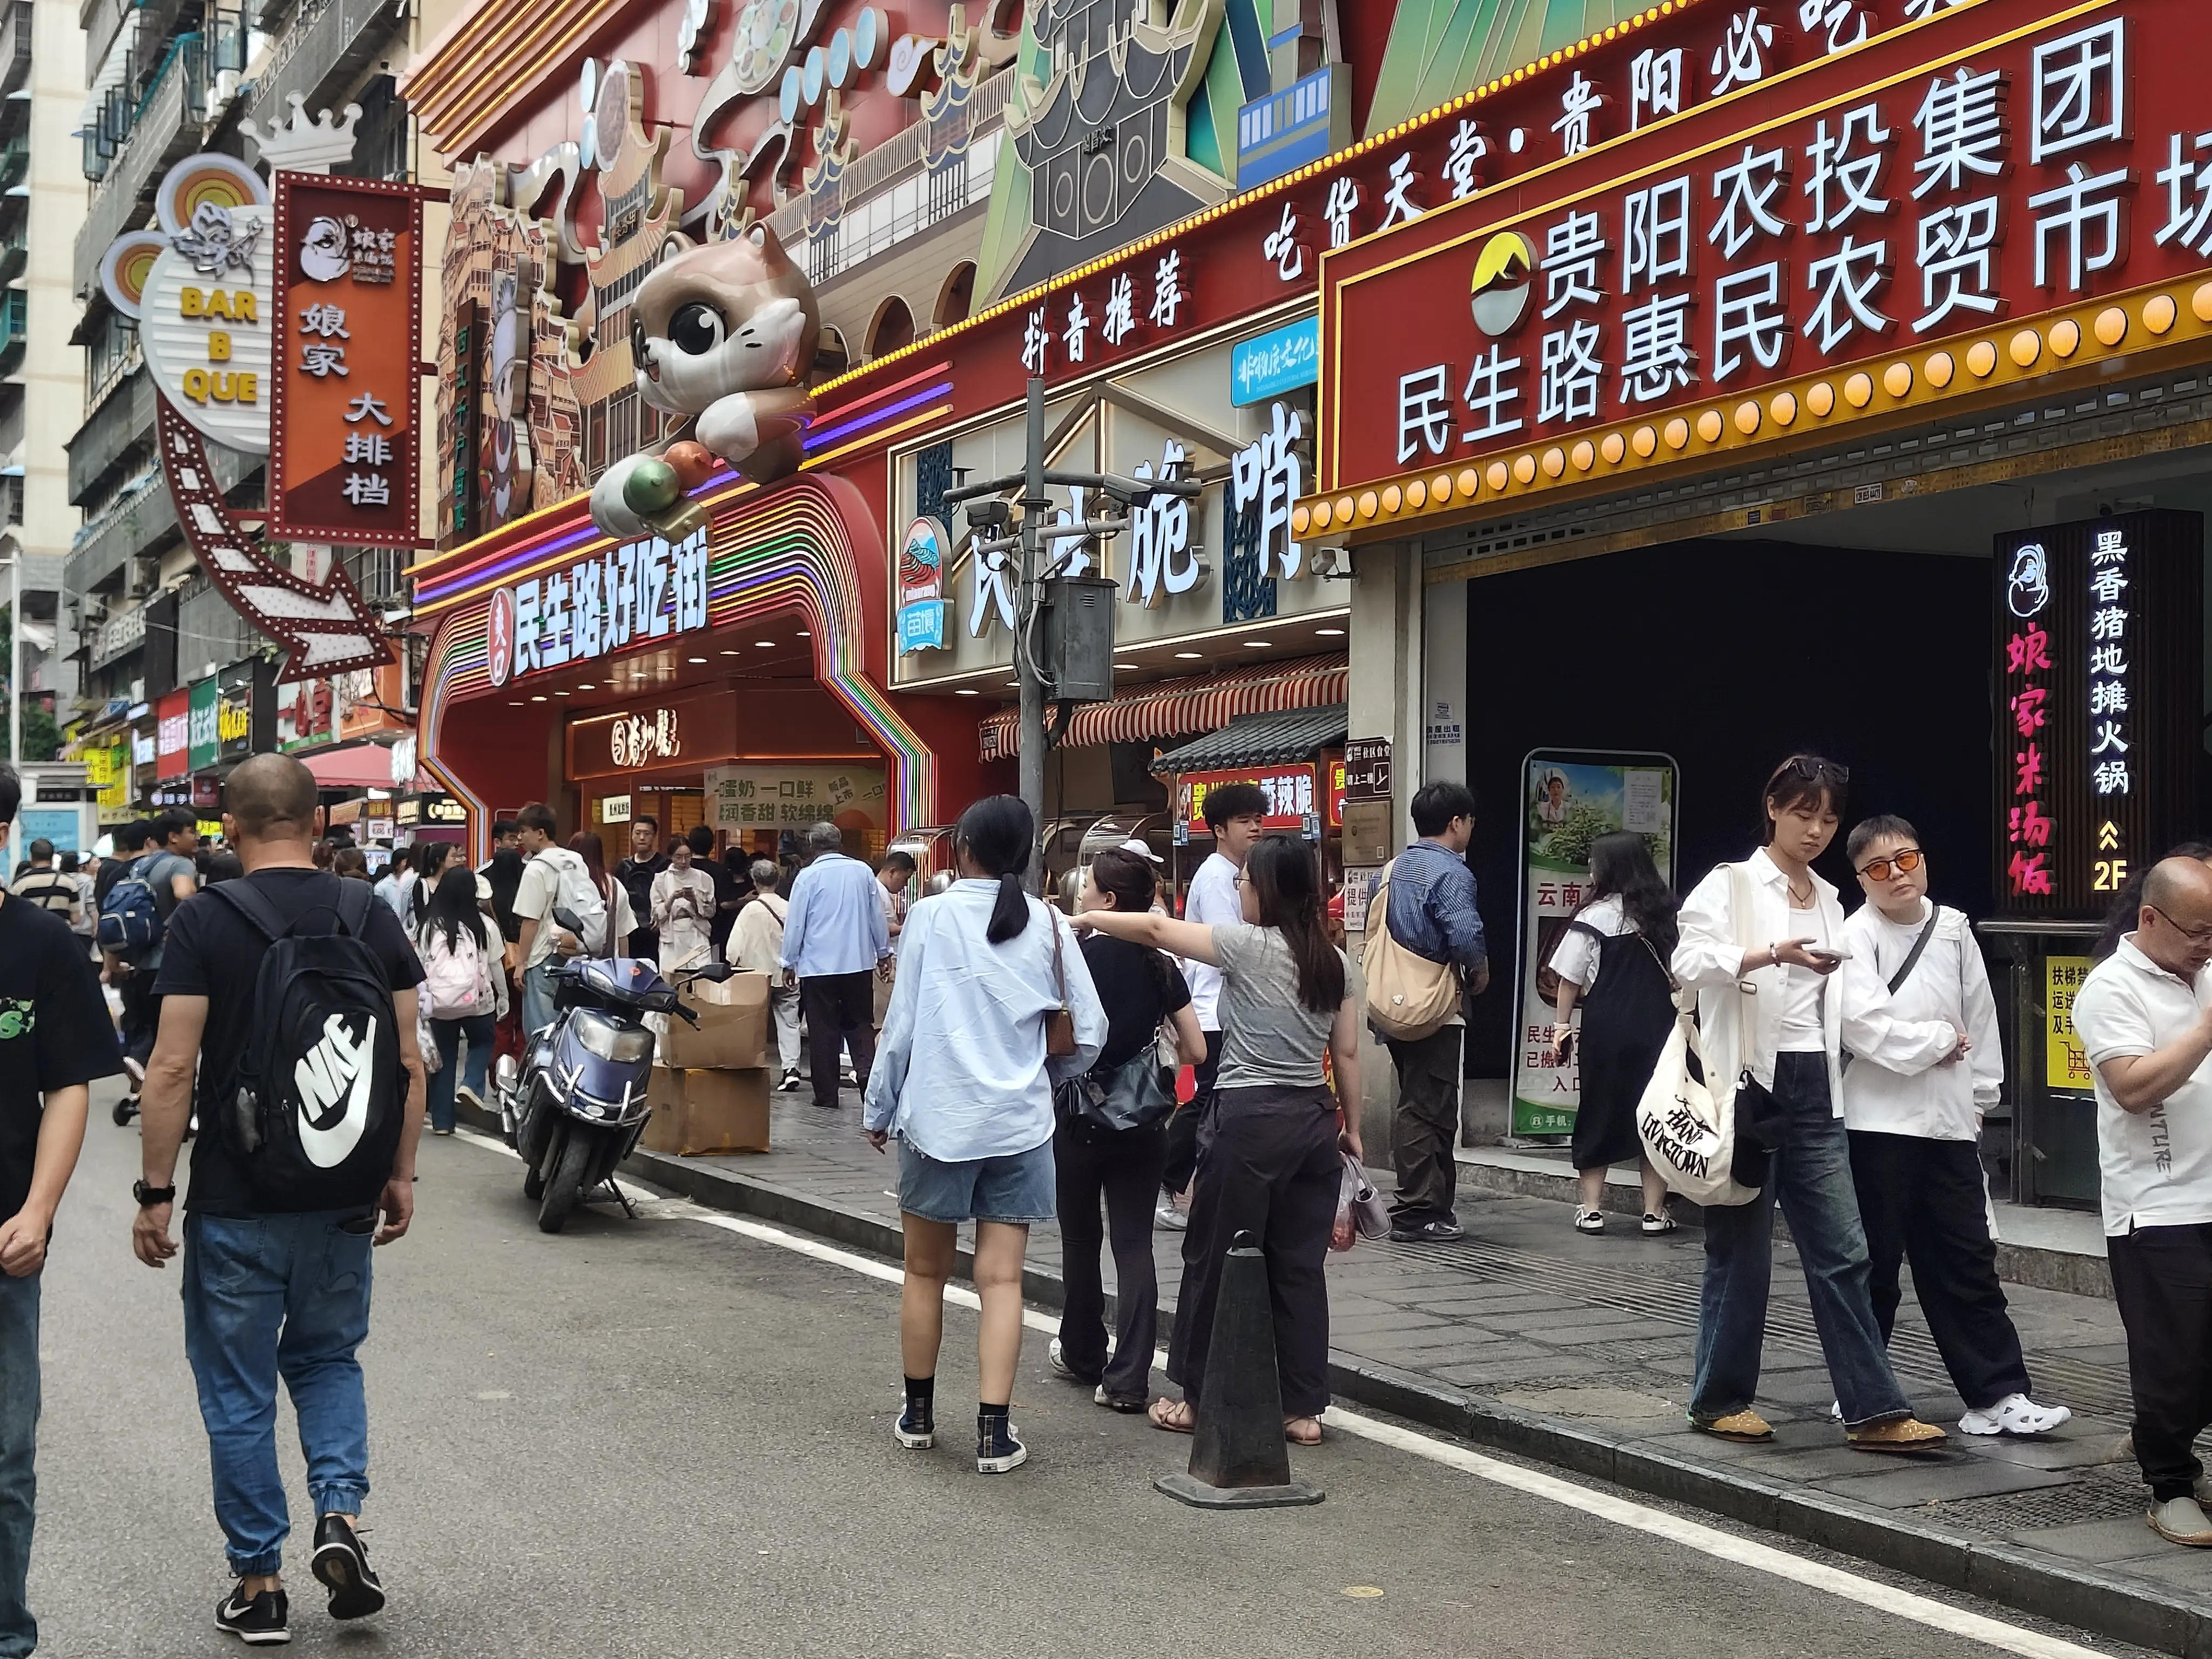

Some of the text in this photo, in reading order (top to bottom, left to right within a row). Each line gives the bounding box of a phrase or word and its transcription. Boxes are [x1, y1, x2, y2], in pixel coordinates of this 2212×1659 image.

[1540, 17, 2126, 320] 贵阳农投集团
[181, 287, 258, 322] BAR
[298, 301, 350, 377] 娘家
[1021, 248, 1184, 374] 抖音推荐
[209, 331, 231, 362] B
[1238, 332, 1319, 394] 非物质文化
[184, 368, 258, 405] QUE
[341, 390, 394, 507] 大排档
[514, 527, 709, 677] 民生路好吃街
[2090, 530, 2129, 796] 黑香猪地摊火锅
[760, 779, 814, 799] 一口鲜
[2005, 622, 2052, 896] 娘家米汤饭
[780, 802, 834, 822] 软绵绵
[835, 788, 854, 806] 上市
[2093, 860, 2128, 892] 2F
[295, 1014, 363, 1123] NIKE
